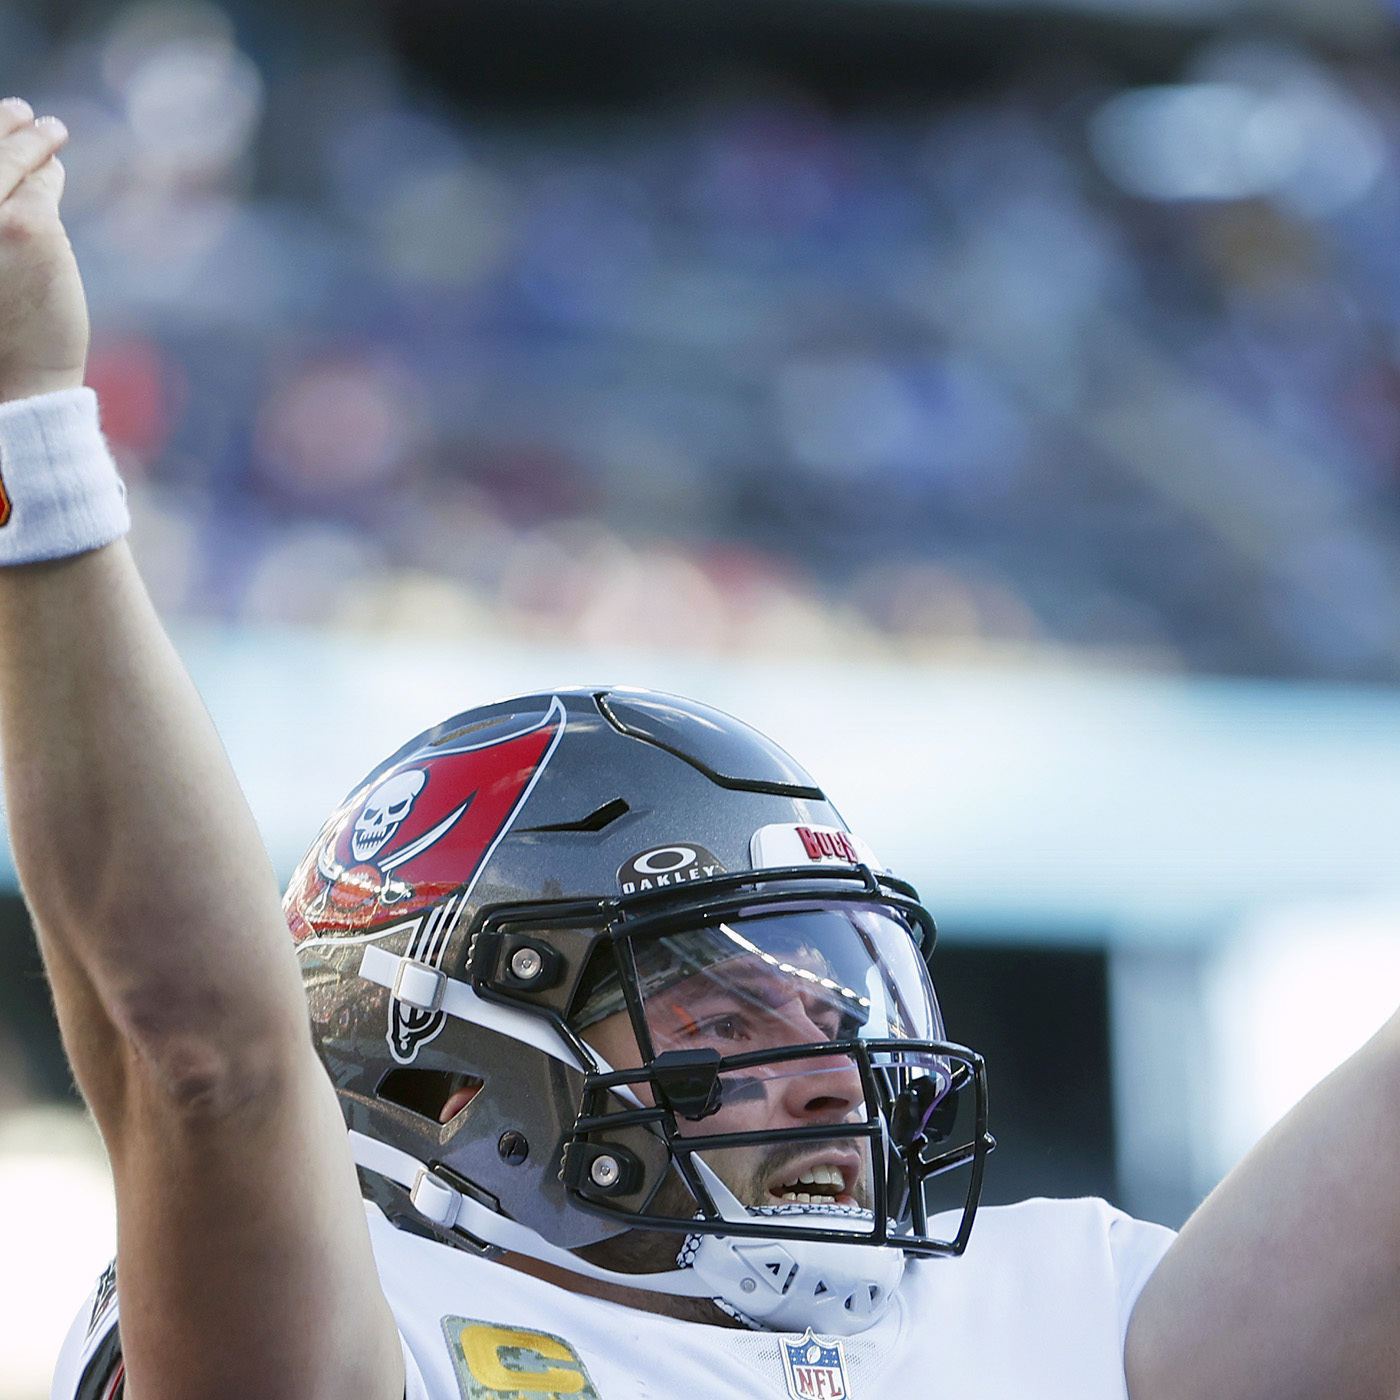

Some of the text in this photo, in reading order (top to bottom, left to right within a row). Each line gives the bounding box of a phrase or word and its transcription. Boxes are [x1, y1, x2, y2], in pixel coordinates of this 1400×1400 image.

[621, 865, 717, 895] OAKLEY
[460, 1324, 585, 1393] C
[796, 1368, 842, 1400] NFL
